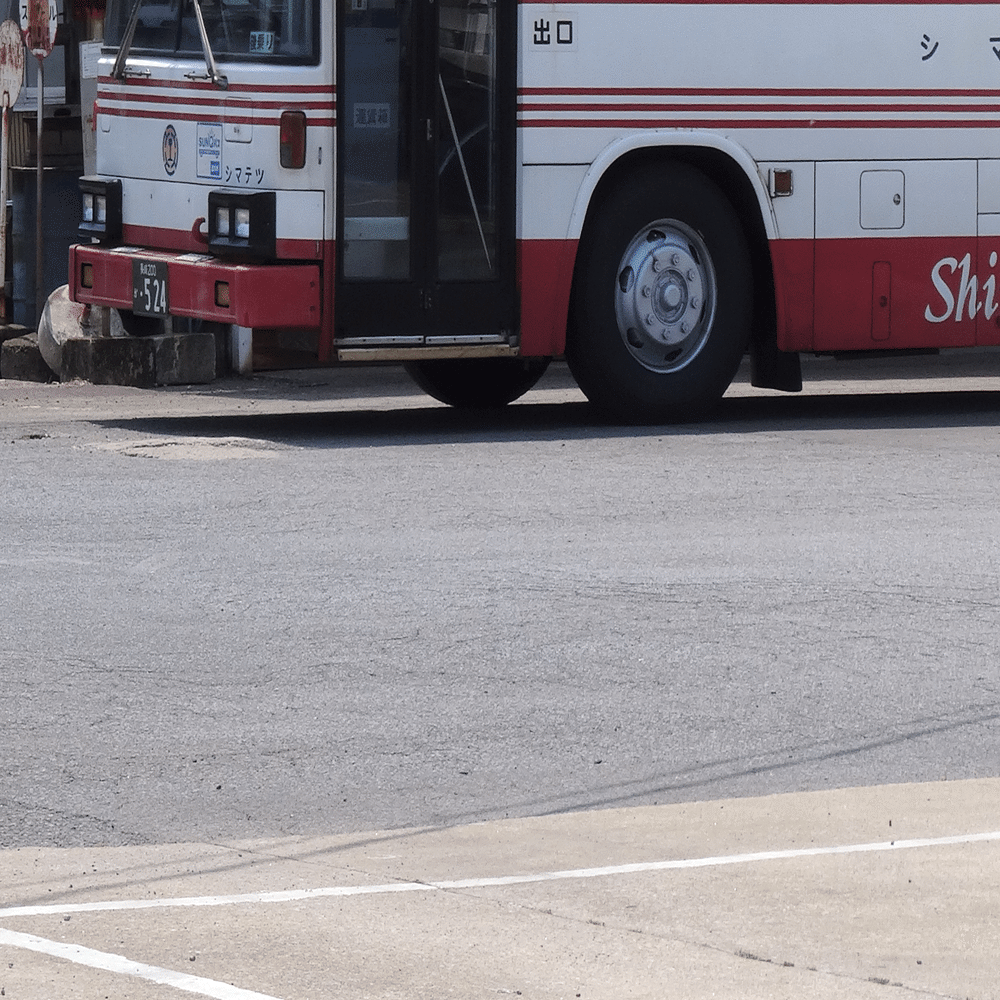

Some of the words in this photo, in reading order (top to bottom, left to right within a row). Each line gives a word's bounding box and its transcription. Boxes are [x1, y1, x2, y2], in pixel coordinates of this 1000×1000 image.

[533, 18, 573, 45] 出口
[225, 165, 265, 185] シマテツ
